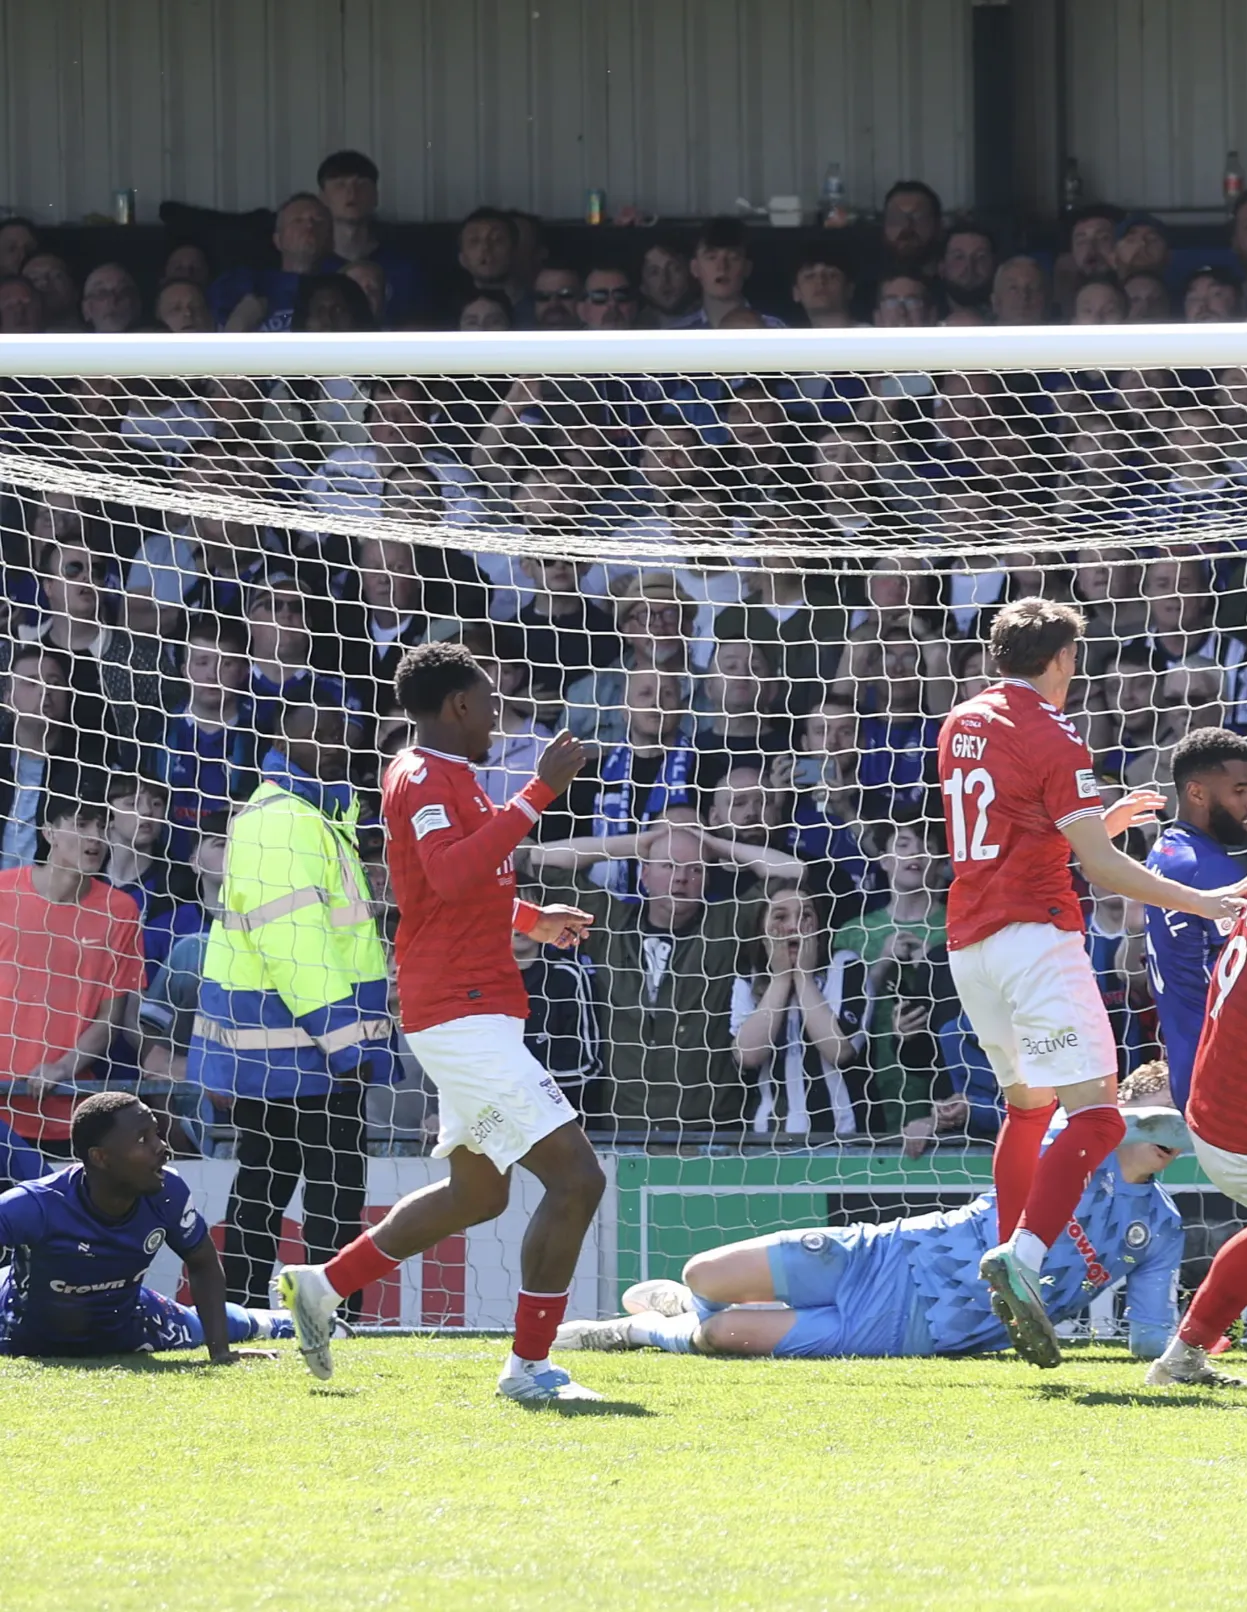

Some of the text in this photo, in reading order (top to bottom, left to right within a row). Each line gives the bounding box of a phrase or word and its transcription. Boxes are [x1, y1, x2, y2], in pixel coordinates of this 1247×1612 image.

[952, 733, 988, 761] GREY
[944, 768, 999, 862] 12
[50, 1280, 126, 1295] Crown
